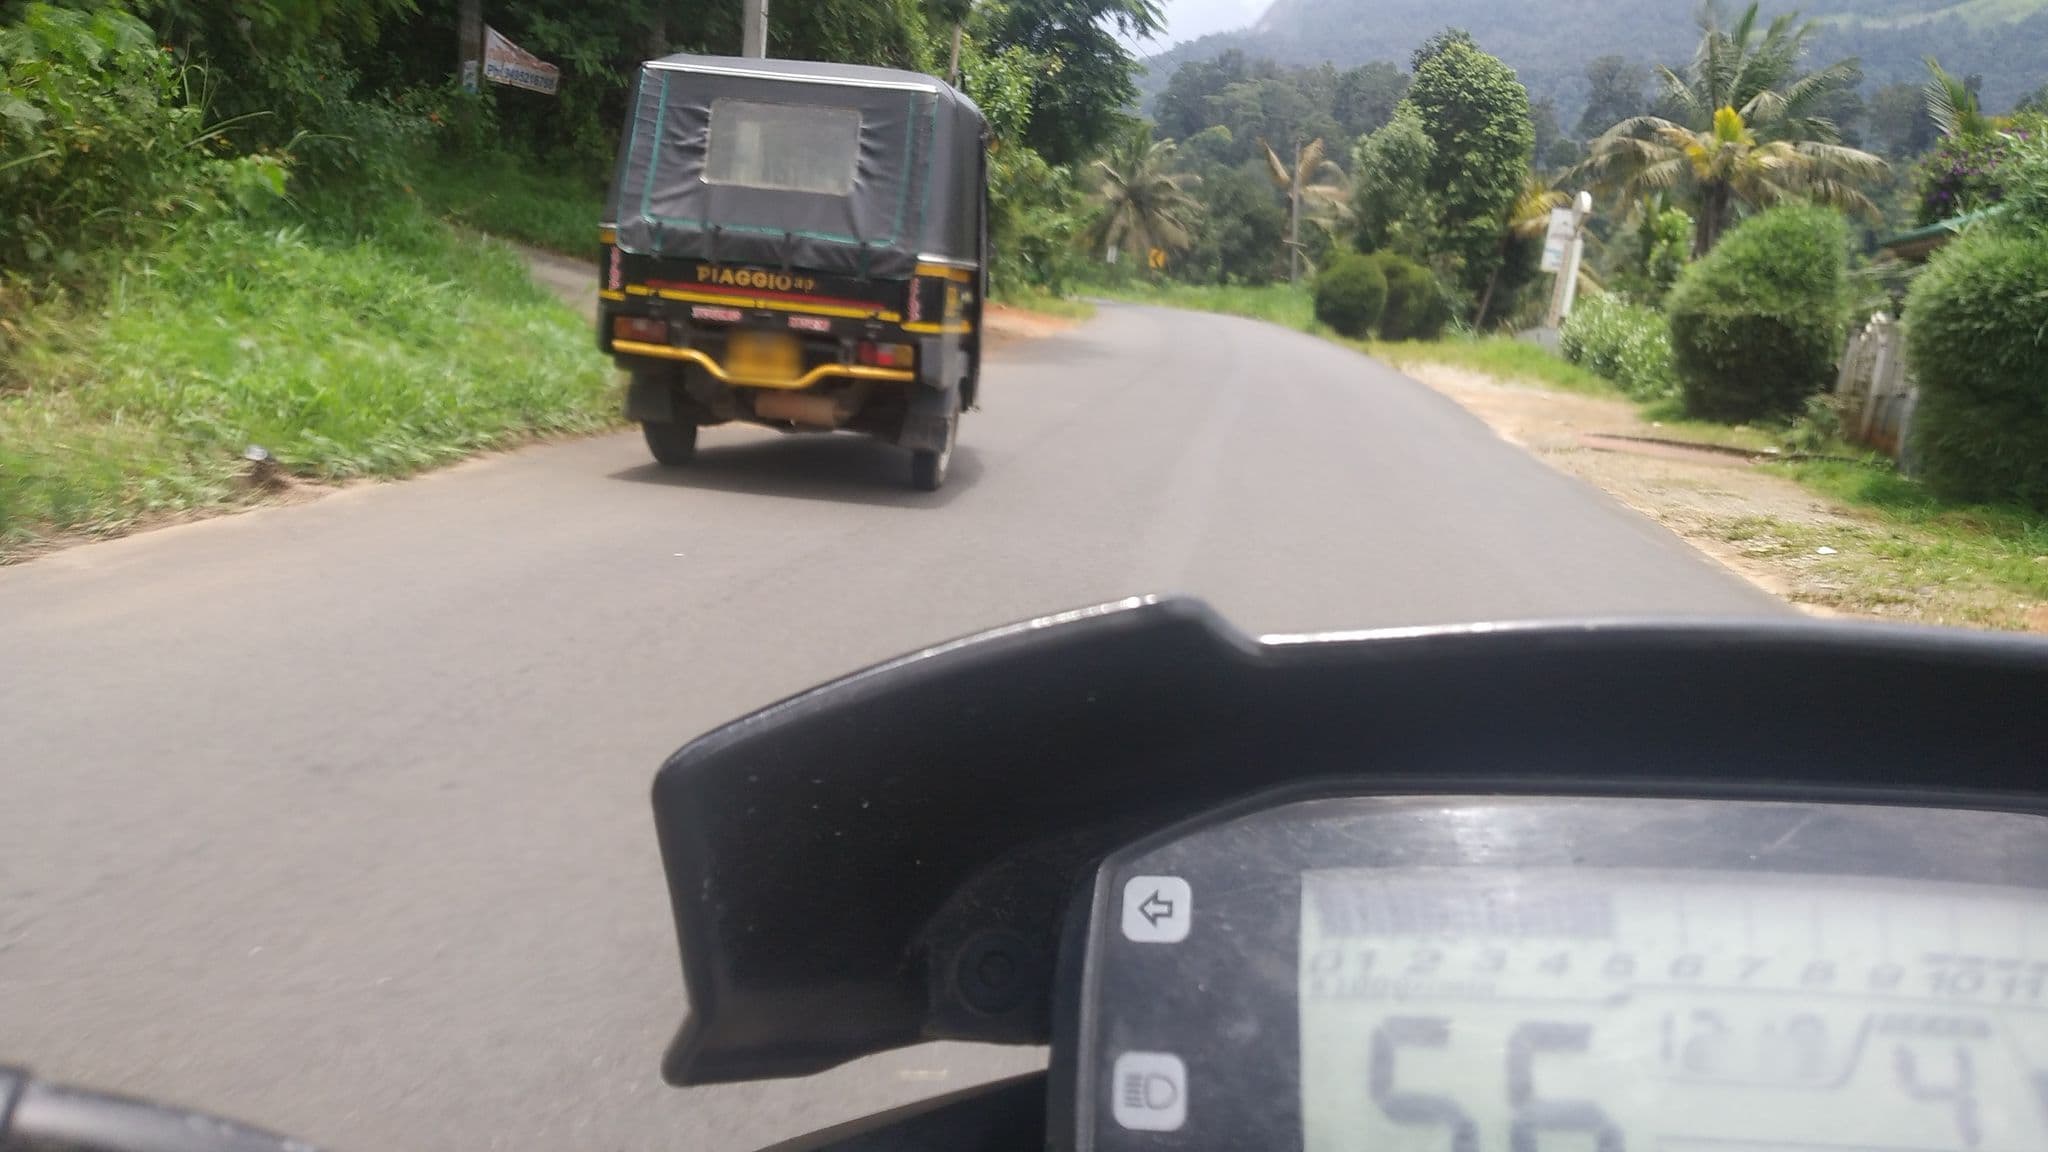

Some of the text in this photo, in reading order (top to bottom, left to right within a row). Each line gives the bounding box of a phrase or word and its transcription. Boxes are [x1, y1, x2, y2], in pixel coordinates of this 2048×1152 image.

[696, 264, 792, 291] PIAGGIO
[1406, 949, 1444, 974] 2
[1537, 951, 1571, 977] 4
[1891, 1044, 1983, 1148] 4
